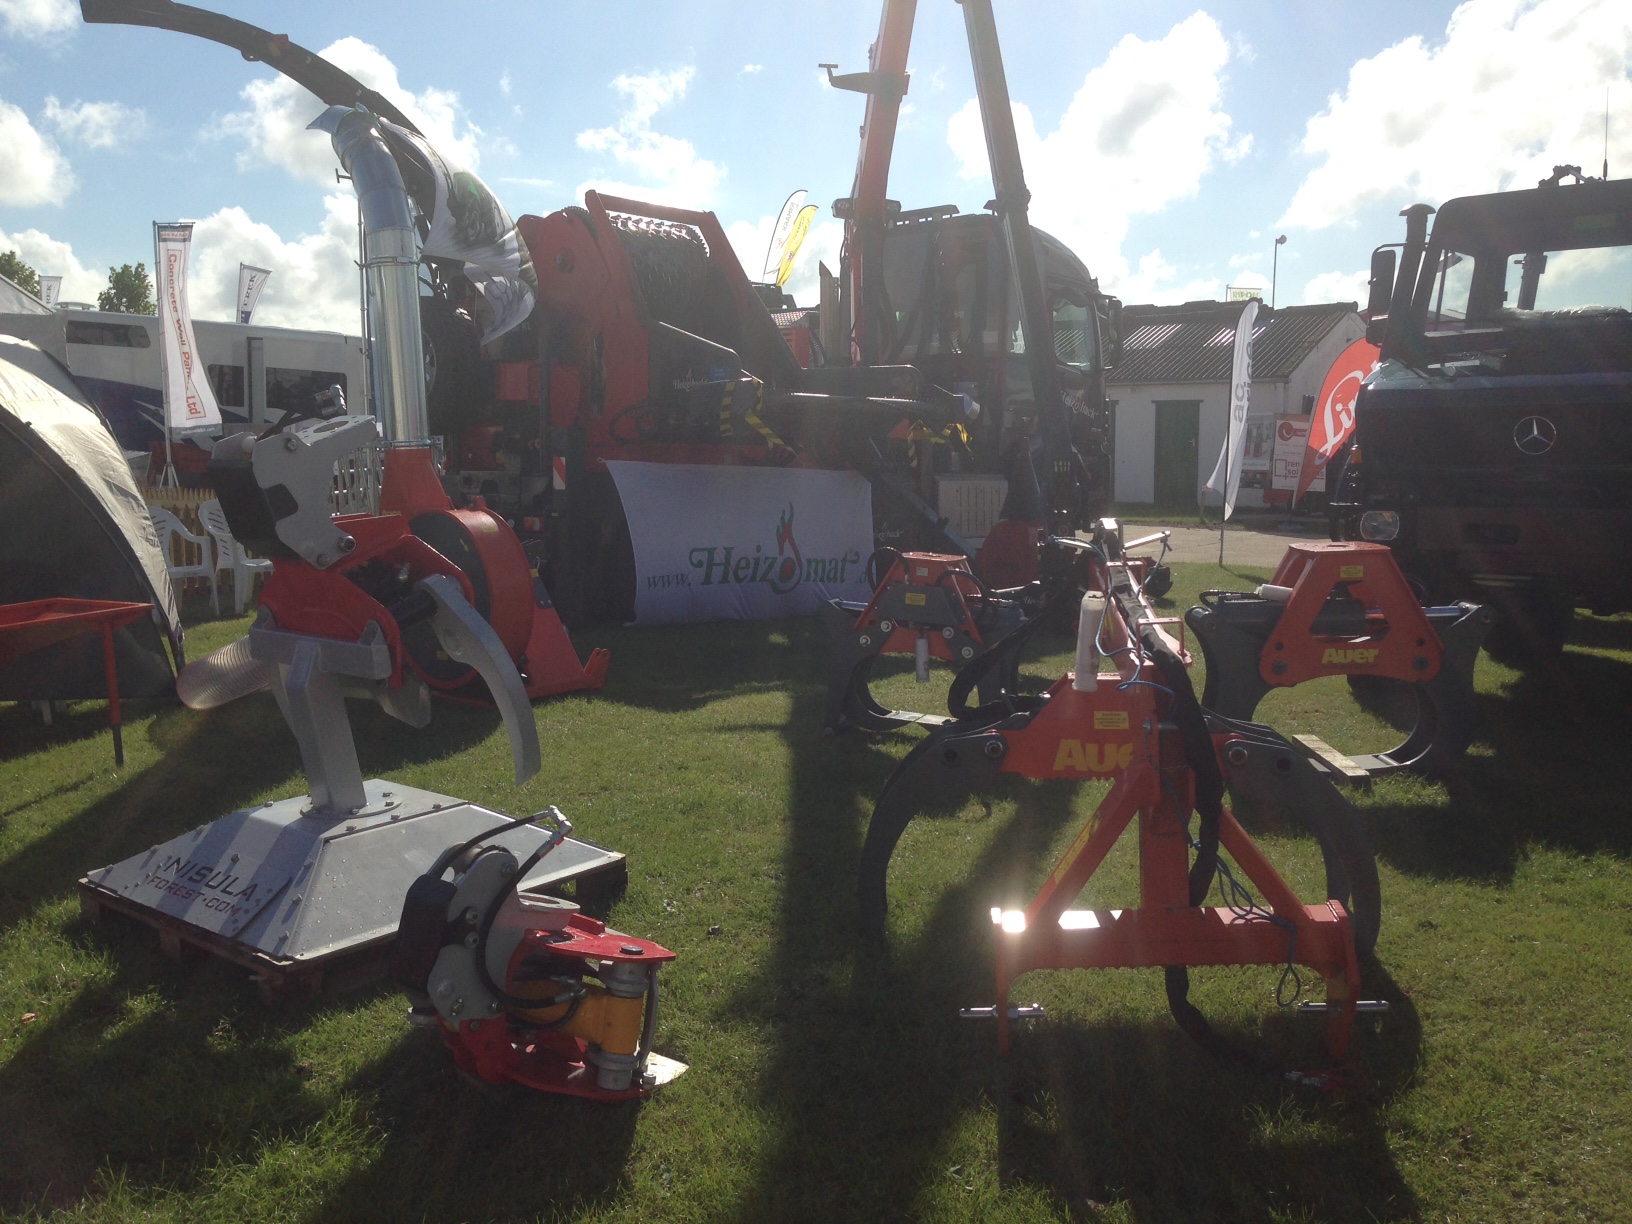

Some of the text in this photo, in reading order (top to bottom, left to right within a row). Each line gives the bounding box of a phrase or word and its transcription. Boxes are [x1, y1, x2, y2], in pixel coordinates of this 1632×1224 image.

[168, 253, 178, 313] Concrete
[186, 395, 201, 415] Ltd
[1234, 382, 1245, 423] ac
[164, 857, 258, 902] NISULA
